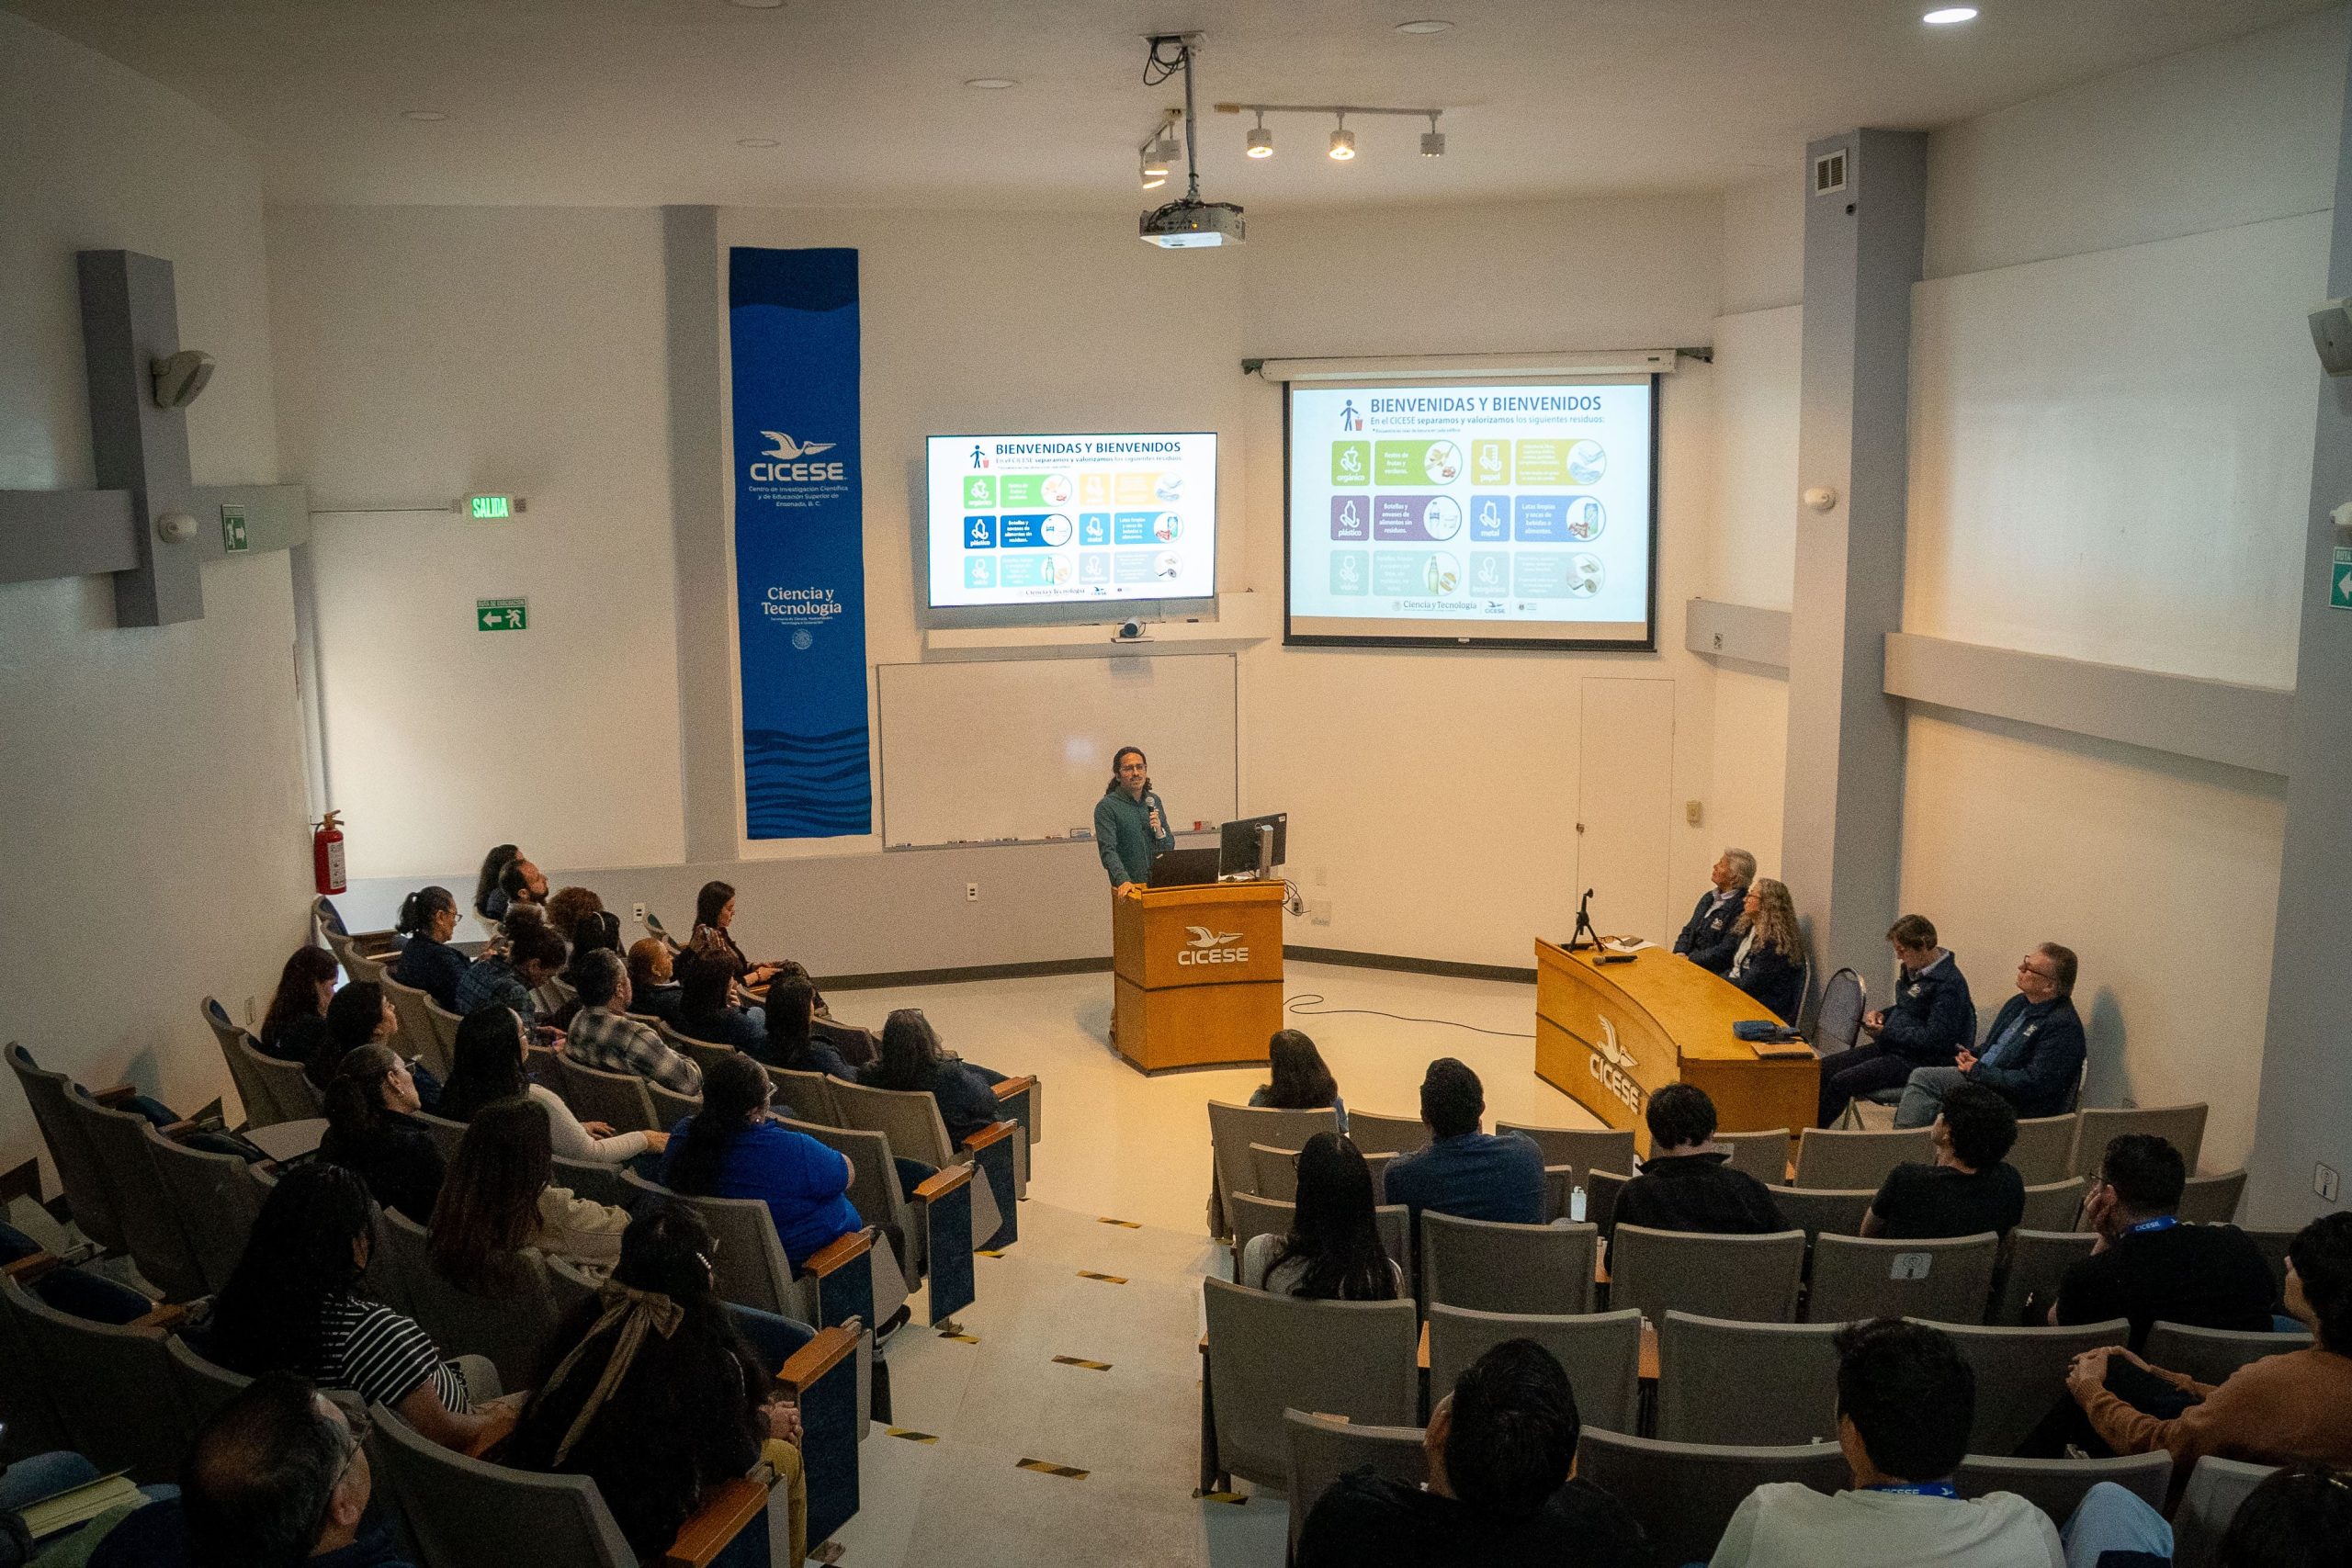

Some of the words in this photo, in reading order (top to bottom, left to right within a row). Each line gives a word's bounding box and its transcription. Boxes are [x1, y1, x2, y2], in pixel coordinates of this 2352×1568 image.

[1371, 398, 1475, 412] BIENVENIDAS
[1479, 397, 1488, 412] Y
[1493, 396, 1601, 411] BIENVENIDOS
[1381, 416, 1388, 424] el
[1389, 416, 1415, 424] CICESE
[1417, 417, 1459, 425] separamos
[1460, 417, 1465, 425] y
[1467, 414, 1514, 423] valorizamos
[1516, 415, 1527, 423] los
[1529, 415, 1567, 425] siguientes
[996, 443, 1082, 455] BIENVENIDAS
[1085, 443, 1092, 453] Y
[1096, 442, 1181, 453] BIENVENIDOS
[750, 462, 843, 481] CICESE
[779, 485, 820, 493] Investigación
[472, 497, 509, 518] SALIDA
[1338, 528, 1363, 537] plástico
[767, 586, 823, 601] Ciencia
[825, 589, 834, 602] y
[761, 600, 842, 616] Tecnología
[1403, 600, 1431, 608] Ciencia
[1177, 947, 1250, 965] CICESE
[1589, 1053, 1639, 1116] CICESE
